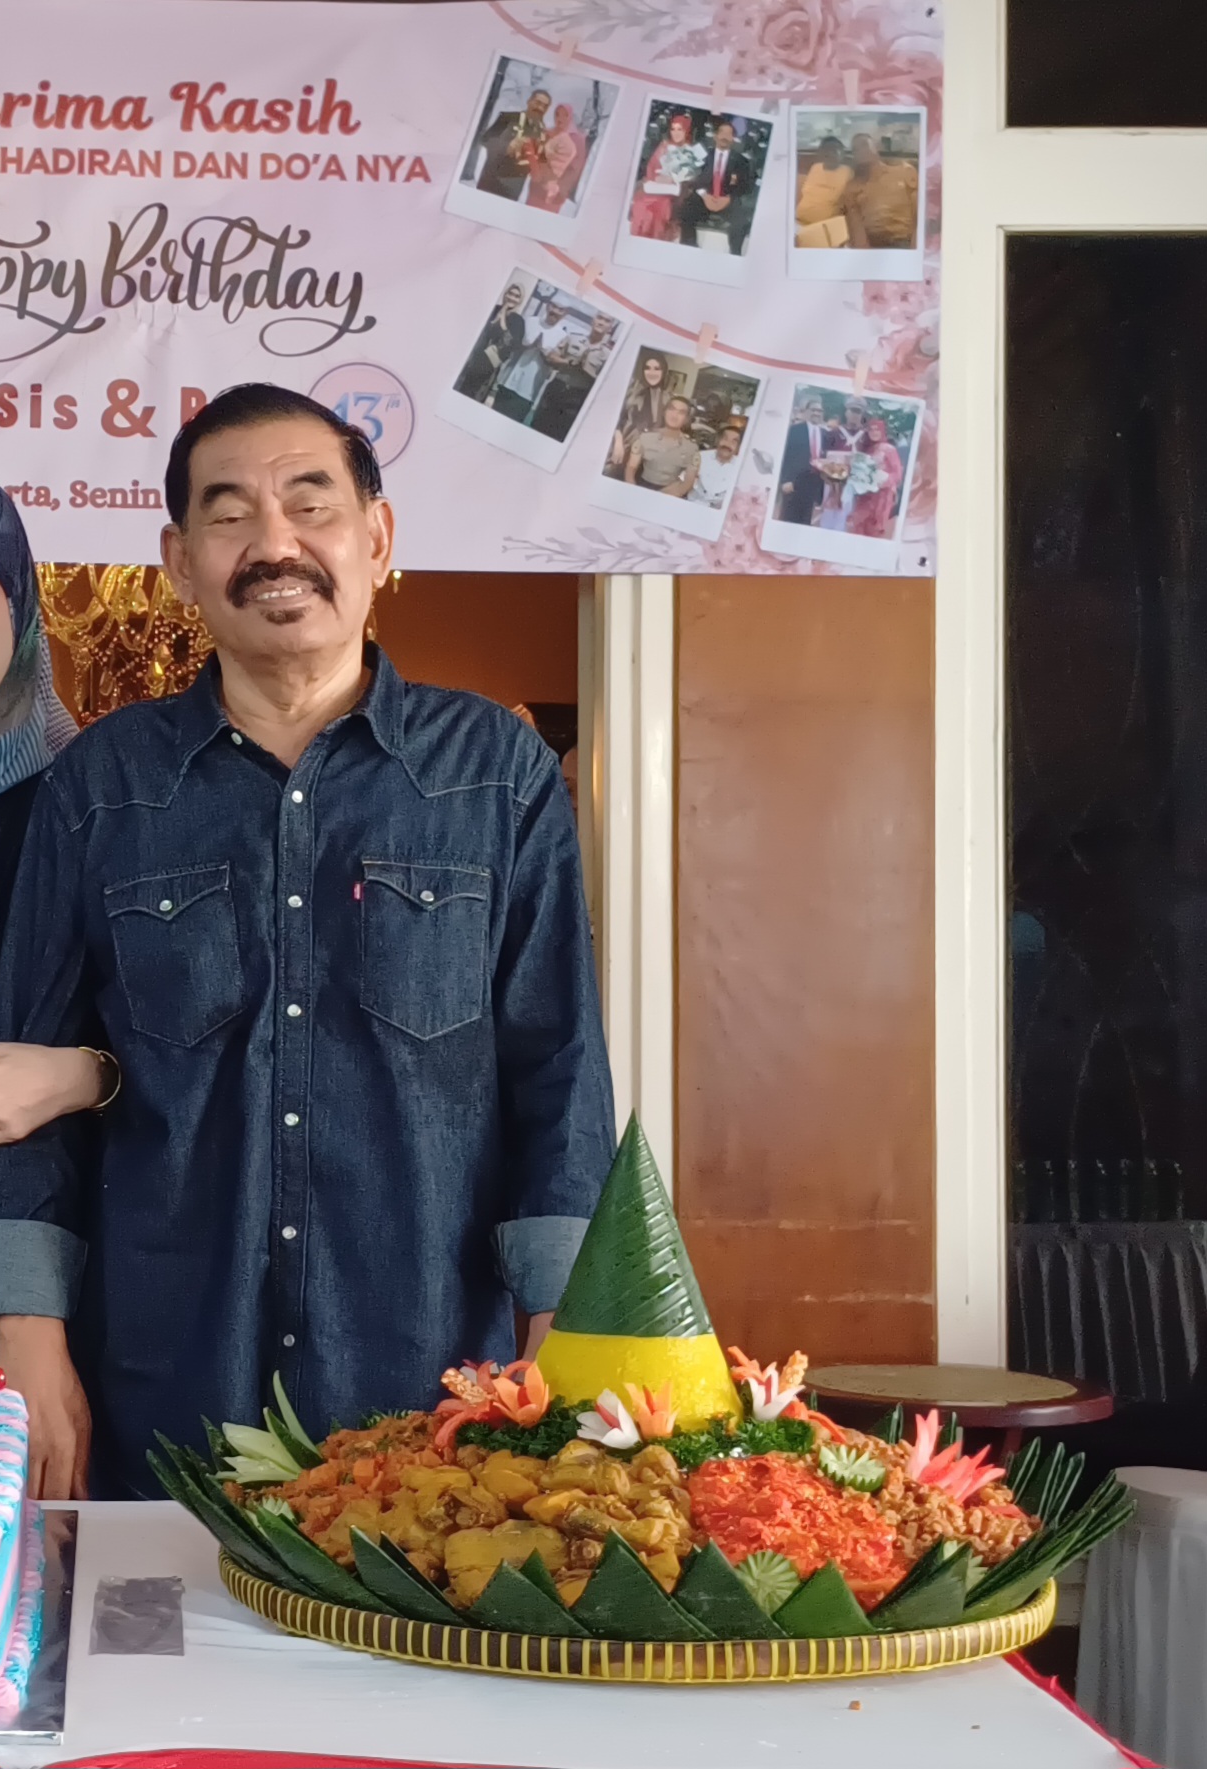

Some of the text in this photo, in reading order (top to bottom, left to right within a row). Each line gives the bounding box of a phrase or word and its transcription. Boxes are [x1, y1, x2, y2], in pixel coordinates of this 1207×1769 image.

[169, 78, 361, 135] Kasih
[173, 151, 248, 179] DAN
[356, 154, 432, 183] NYA
[100, 202, 377, 358] Birthday
[100, 378, 158, 438] &
[69, 479, 163, 509] Senin
